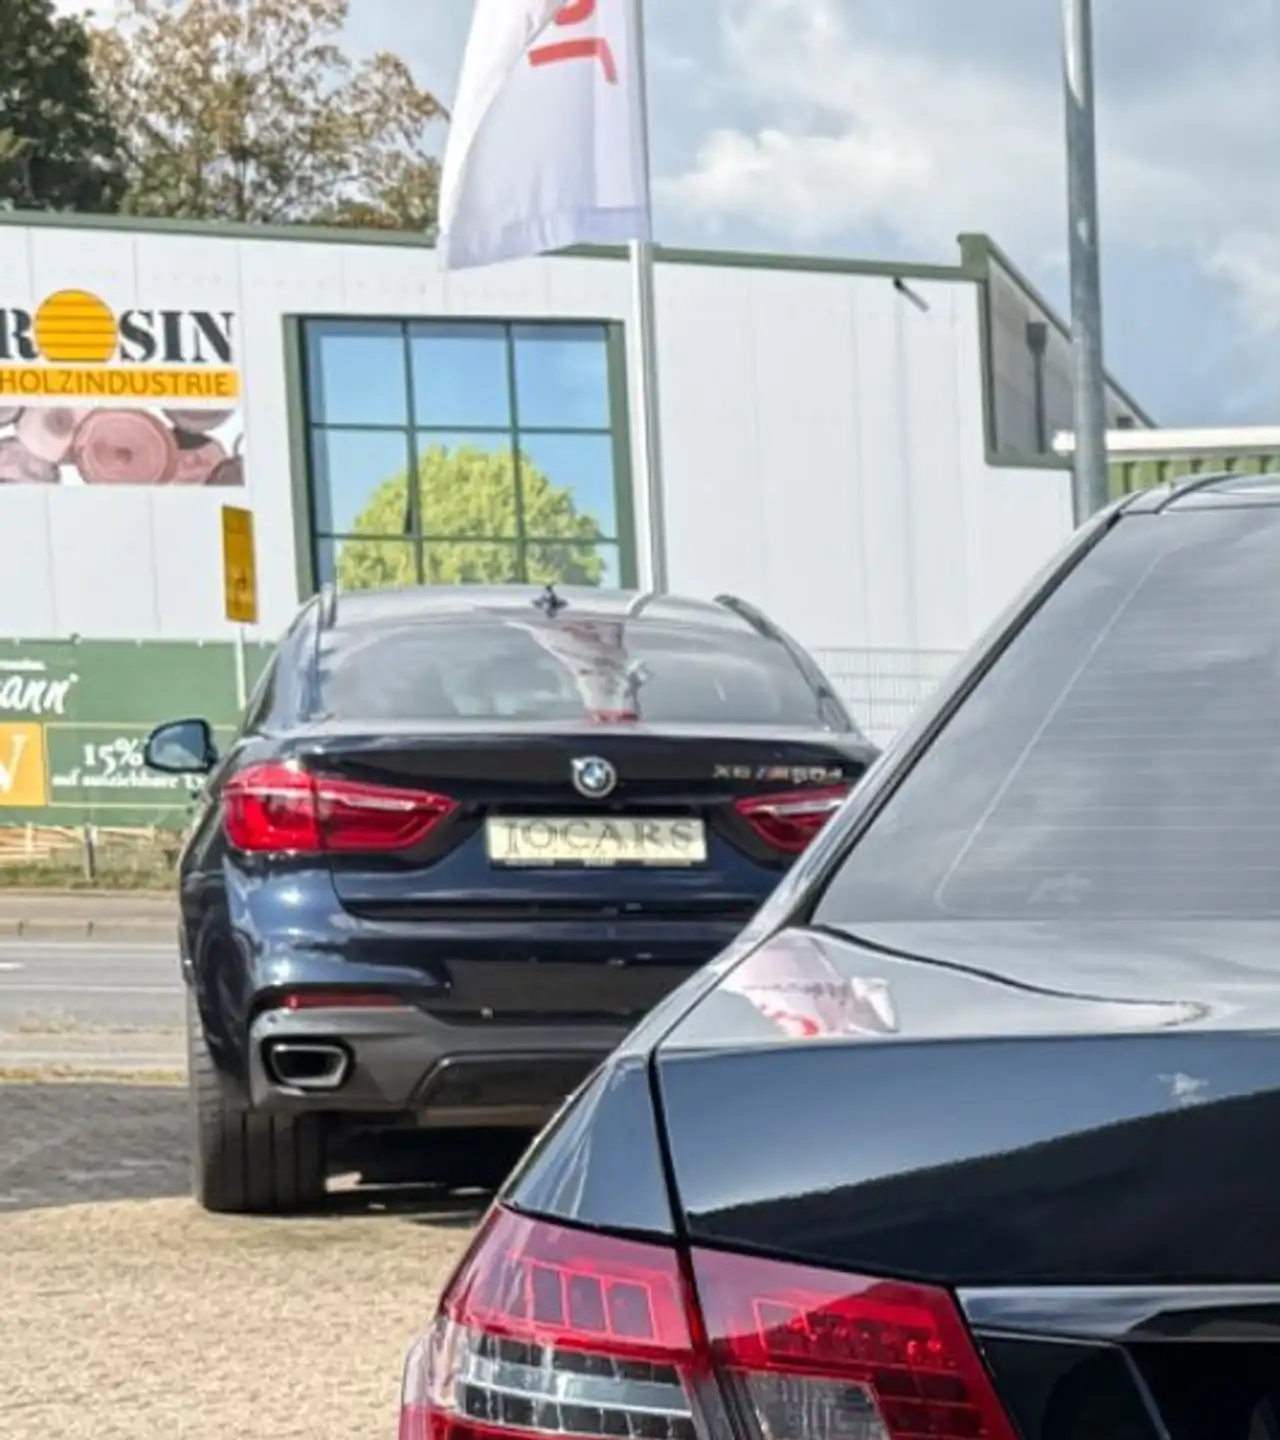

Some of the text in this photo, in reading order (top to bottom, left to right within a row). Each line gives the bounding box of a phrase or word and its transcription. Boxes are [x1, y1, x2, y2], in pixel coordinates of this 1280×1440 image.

[0, 368, 230, 396] HOLZINDUSTRIE
[83, 738, 143, 777] 15%
[501, 818, 695, 855] JOCARS
